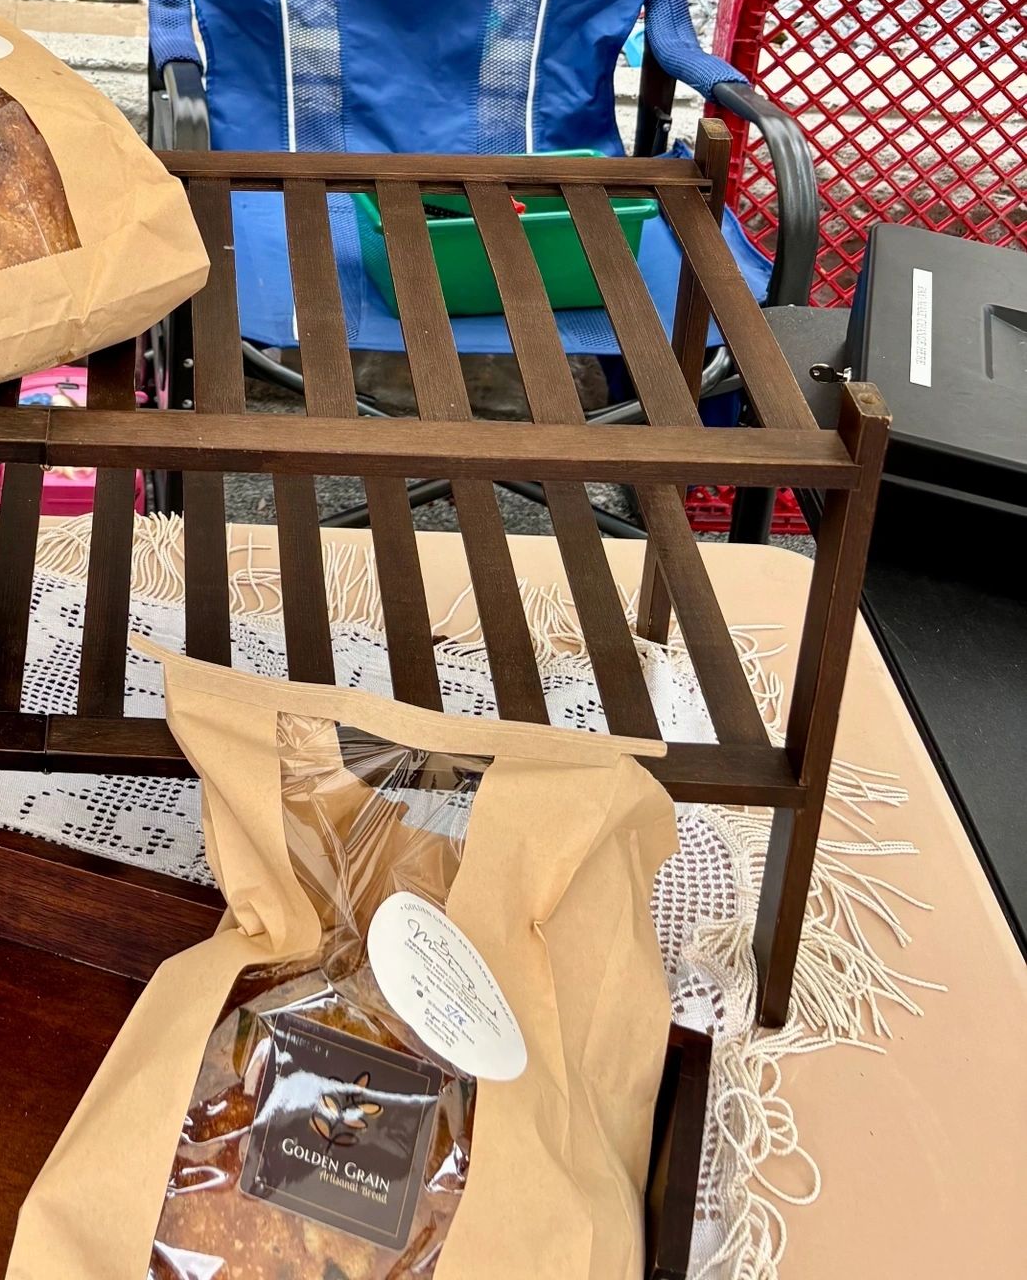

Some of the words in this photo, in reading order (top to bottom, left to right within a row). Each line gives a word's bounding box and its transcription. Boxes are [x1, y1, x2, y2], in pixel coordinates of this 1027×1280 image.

[281, 1138, 339, 1174] GOLDEN
[344, 1161, 391, 1193] GRAIN
[319, 1170, 360, 1194] Artisanal
[361, 1184, 388, 1205] Bread
